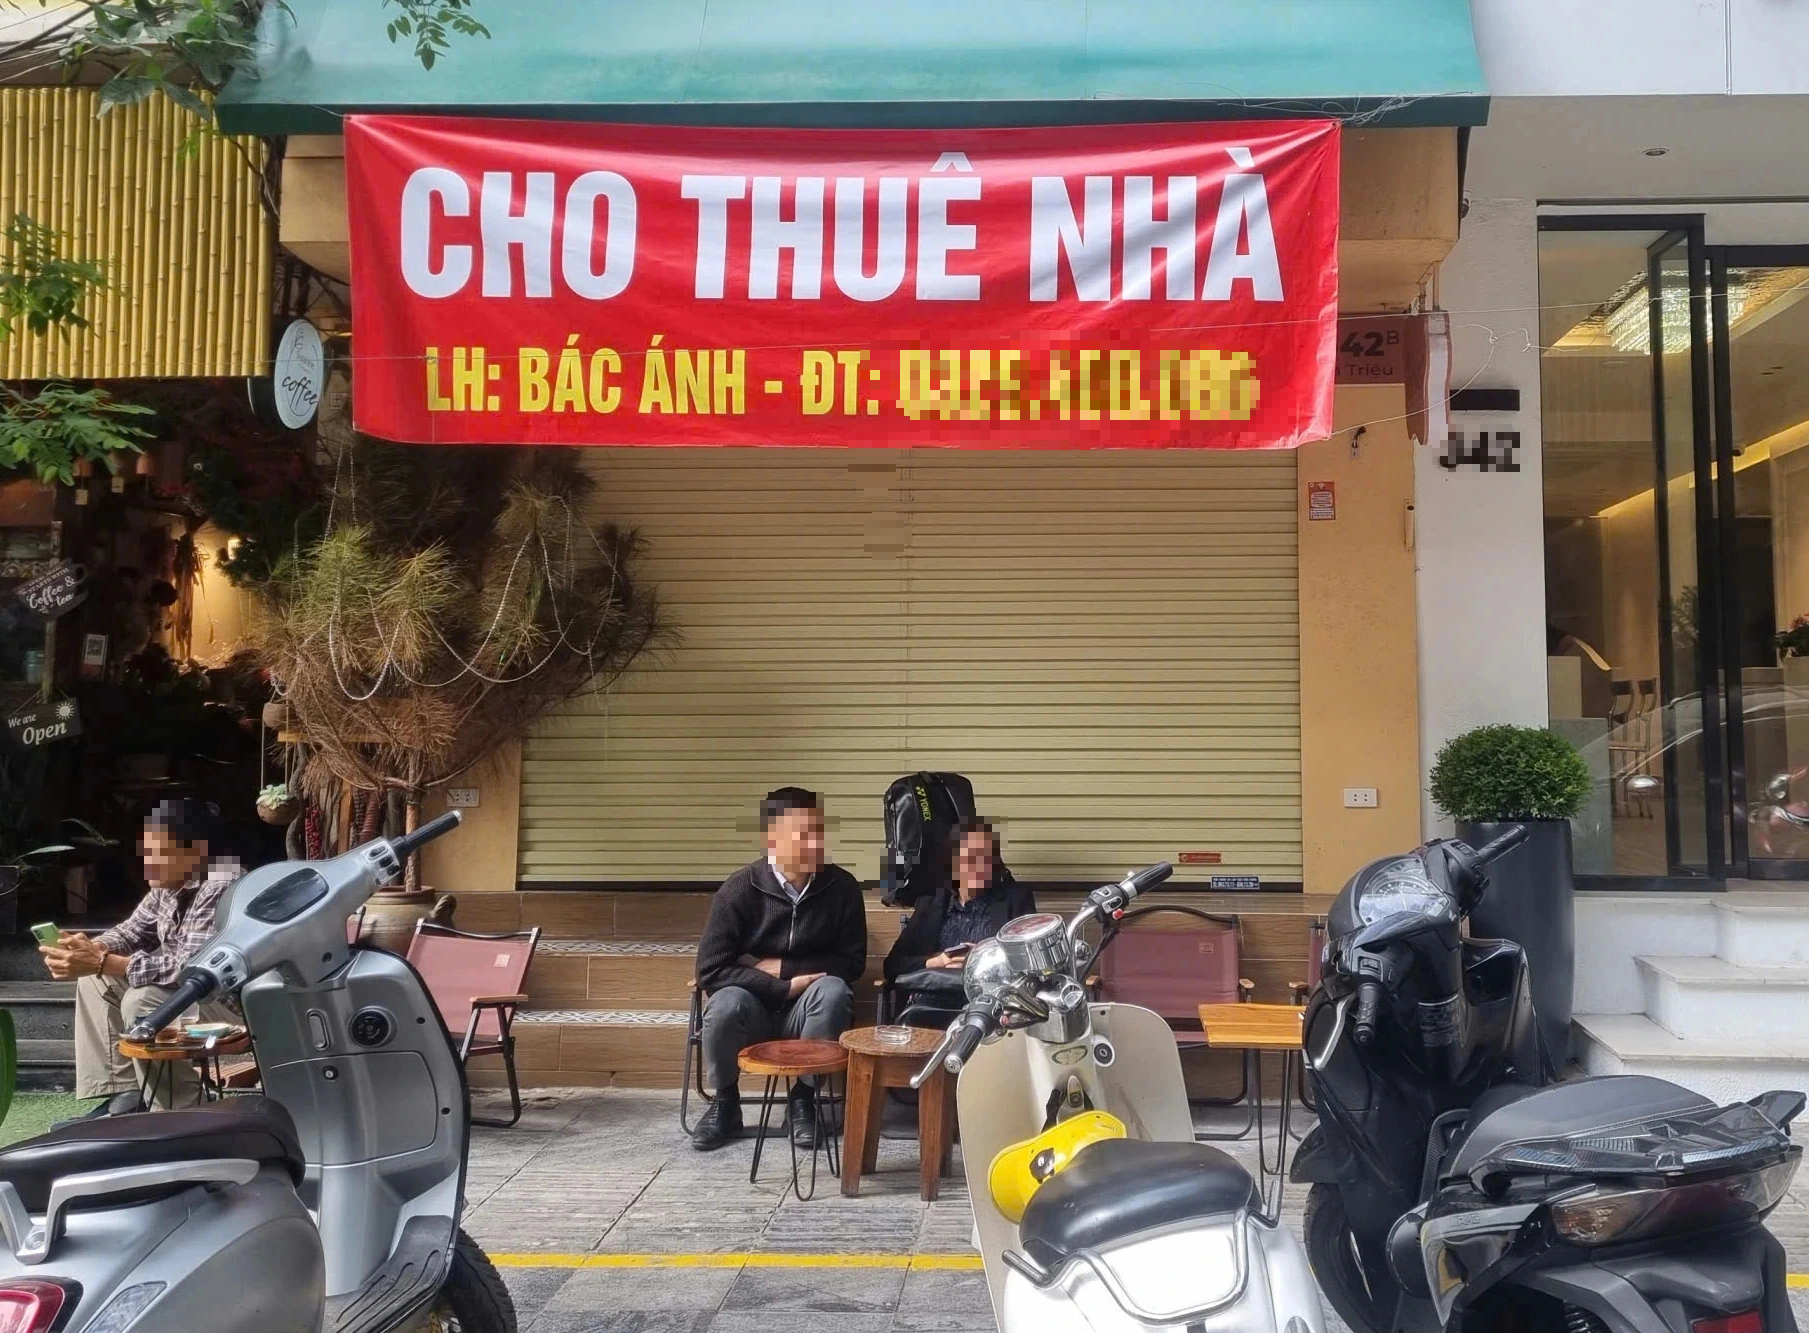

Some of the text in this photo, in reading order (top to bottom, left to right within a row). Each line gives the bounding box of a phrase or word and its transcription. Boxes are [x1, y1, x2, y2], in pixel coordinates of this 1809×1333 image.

[401, 147, 1284, 302] CHO THUÊ NHÀ
[426, 347, 500, 411] LH:
[519, 334, 622, 414] BÁC
[638, 334, 745, 415] ÁNH
[800, 350, 880, 415] ĐT:
[282, 376, 319, 411] coffee
[26, 585, 64, 609] Coffee
[64, 575, 76, 587] &
[56, 593, 75, 606] tea
[8, 714, 36, 729] We are
[22, 722, 68, 746] Open
[919, 798, 932, 821] YONEX
